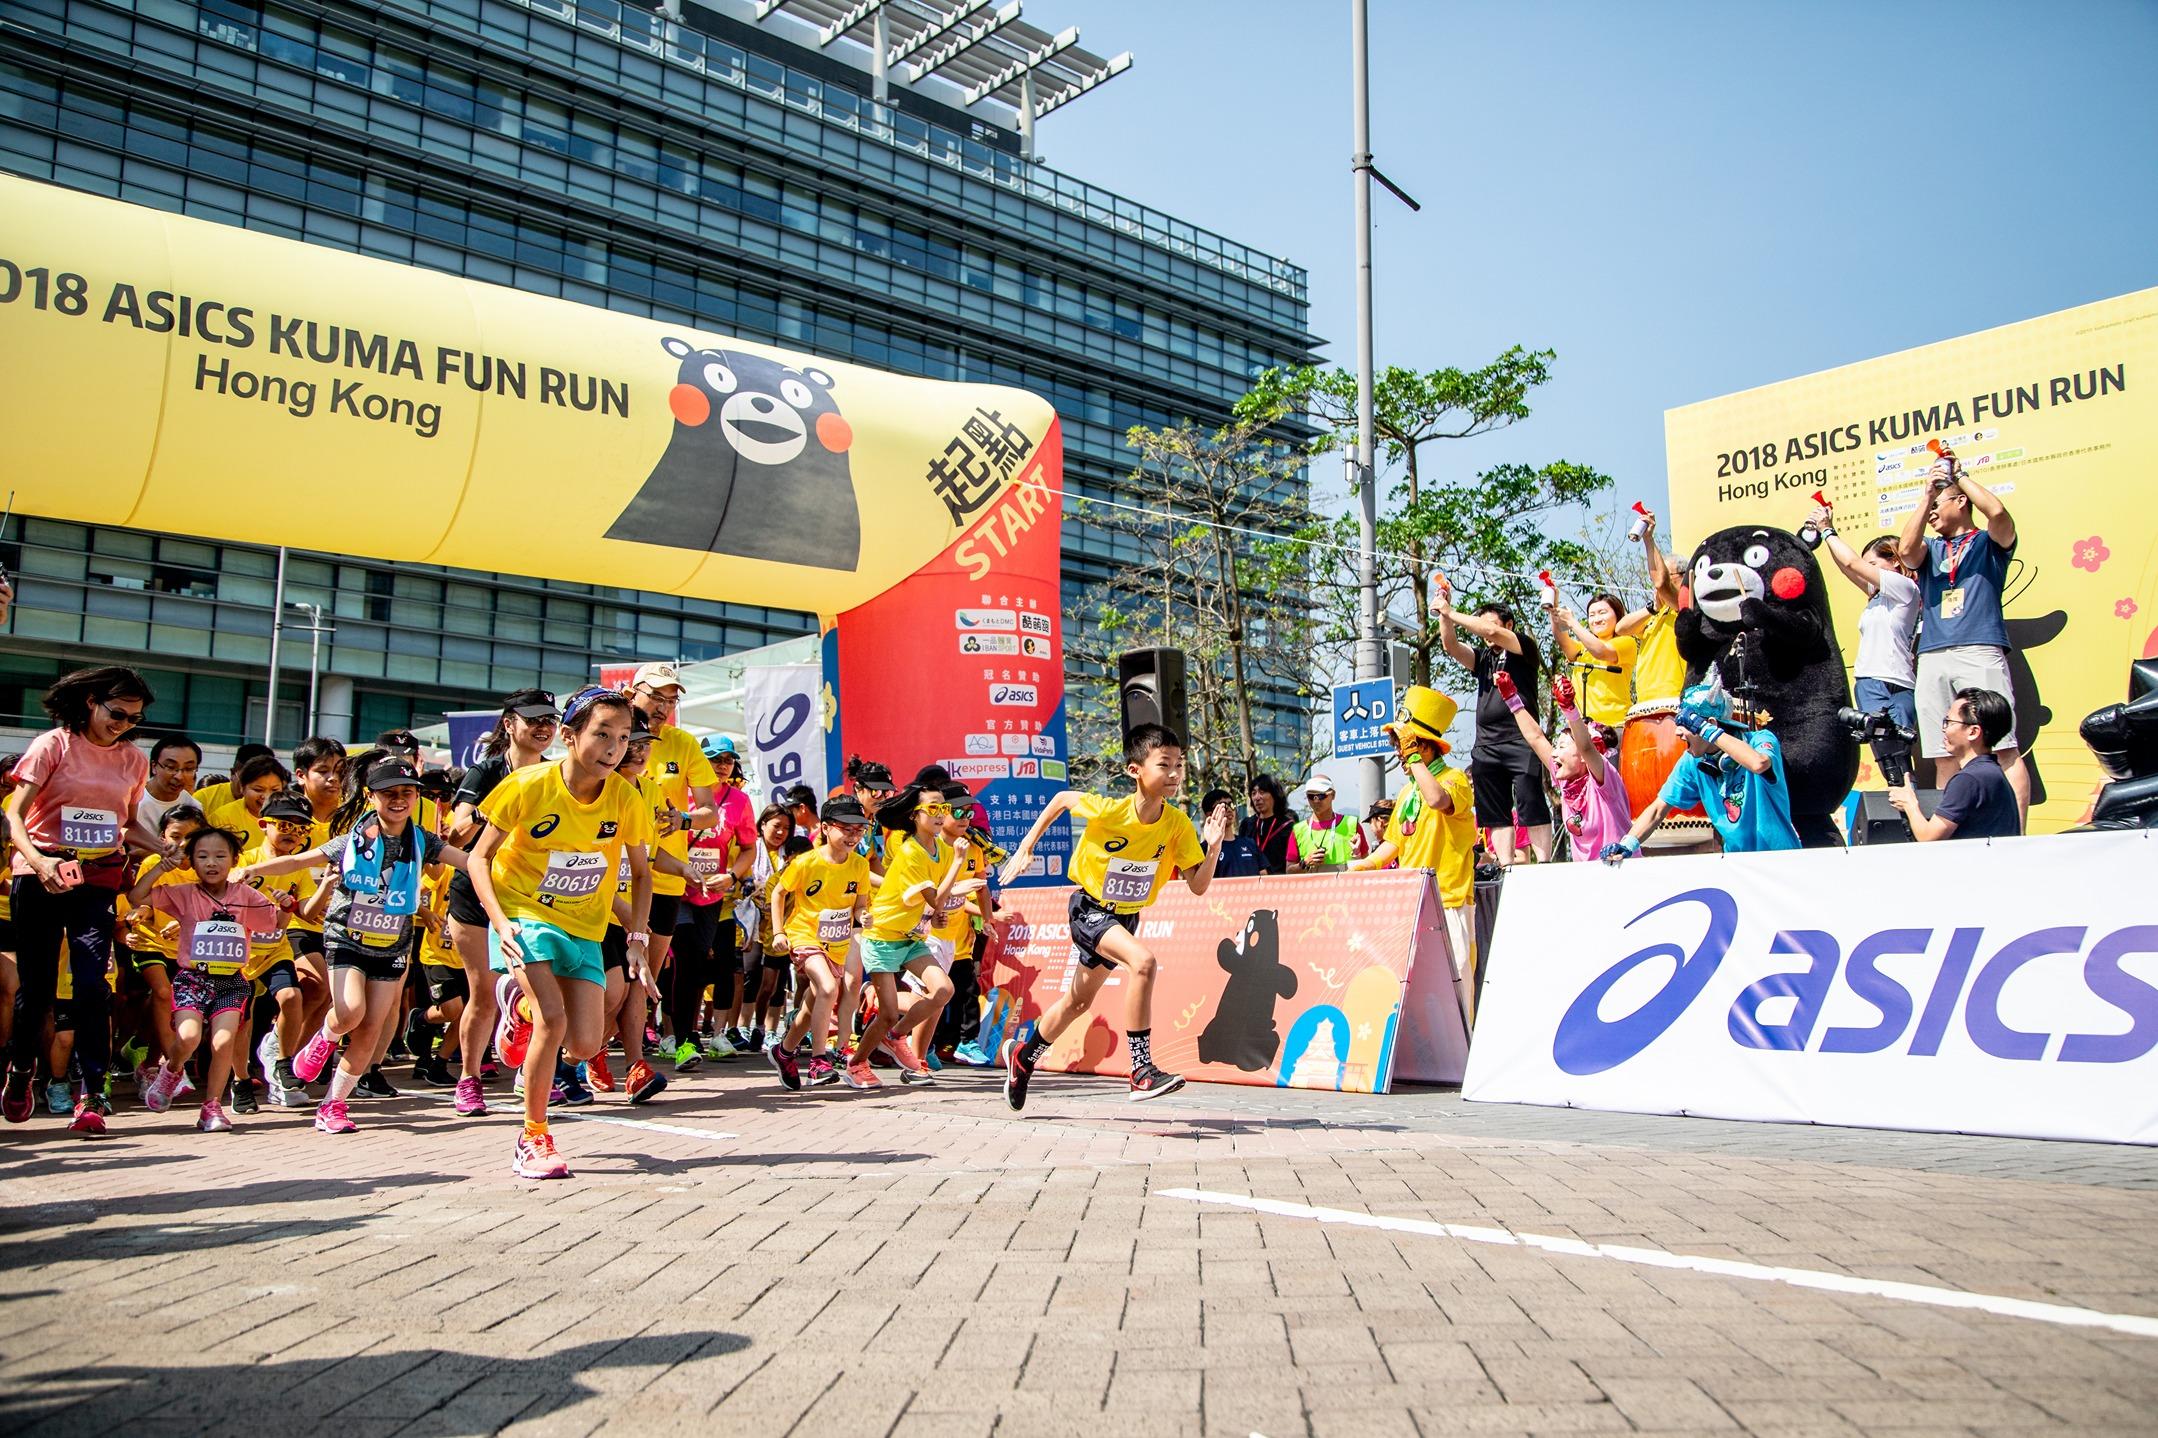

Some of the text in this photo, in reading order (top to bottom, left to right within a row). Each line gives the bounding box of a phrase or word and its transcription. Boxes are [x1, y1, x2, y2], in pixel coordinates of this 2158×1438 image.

[102, 282, 255, 348] ASICS
[269, 313, 424, 381] KUMA
[436, 346, 527, 399] FUN
[539, 367, 630, 418] RUN
[194, 354, 442, 438] Hong Kong
[1717, 363, 2127, 478] 2018 ASICS KUMA FUN RUN
[926, 406, 1033, 528] 起點
[1718, 479, 1769, 502] Hong
[1774, 468, 1828, 492] Kong
[954, 464, 1053, 582] START
[1008, 690, 1034, 702] asics
[1372, 700, 1386, 720] D
[1337, 739, 1391, 753] GUEST VEHICLE STO
[1017, 761, 1036, 776] JTB
[984, 810, 1042, 820] 港日本國總
[65, 826, 114, 844] 81115
[544, 873, 601, 892] 80619
[1106, 878, 1150, 897] 81539
[352, 910, 401, 930] 81681
[819, 922, 851, 938] 80845
[1007, 924, 1036, 940] 2018
[1036, 923, 1071, 940] ASICS
[1143, 921, 1174, 938] RUN
[195, 940, 244, 958] 81116
[1003, 944, 1026, 958] Hong
[1026, 943, 1051, 958] Kong
[1728, 924, 2158, 1064] asics
